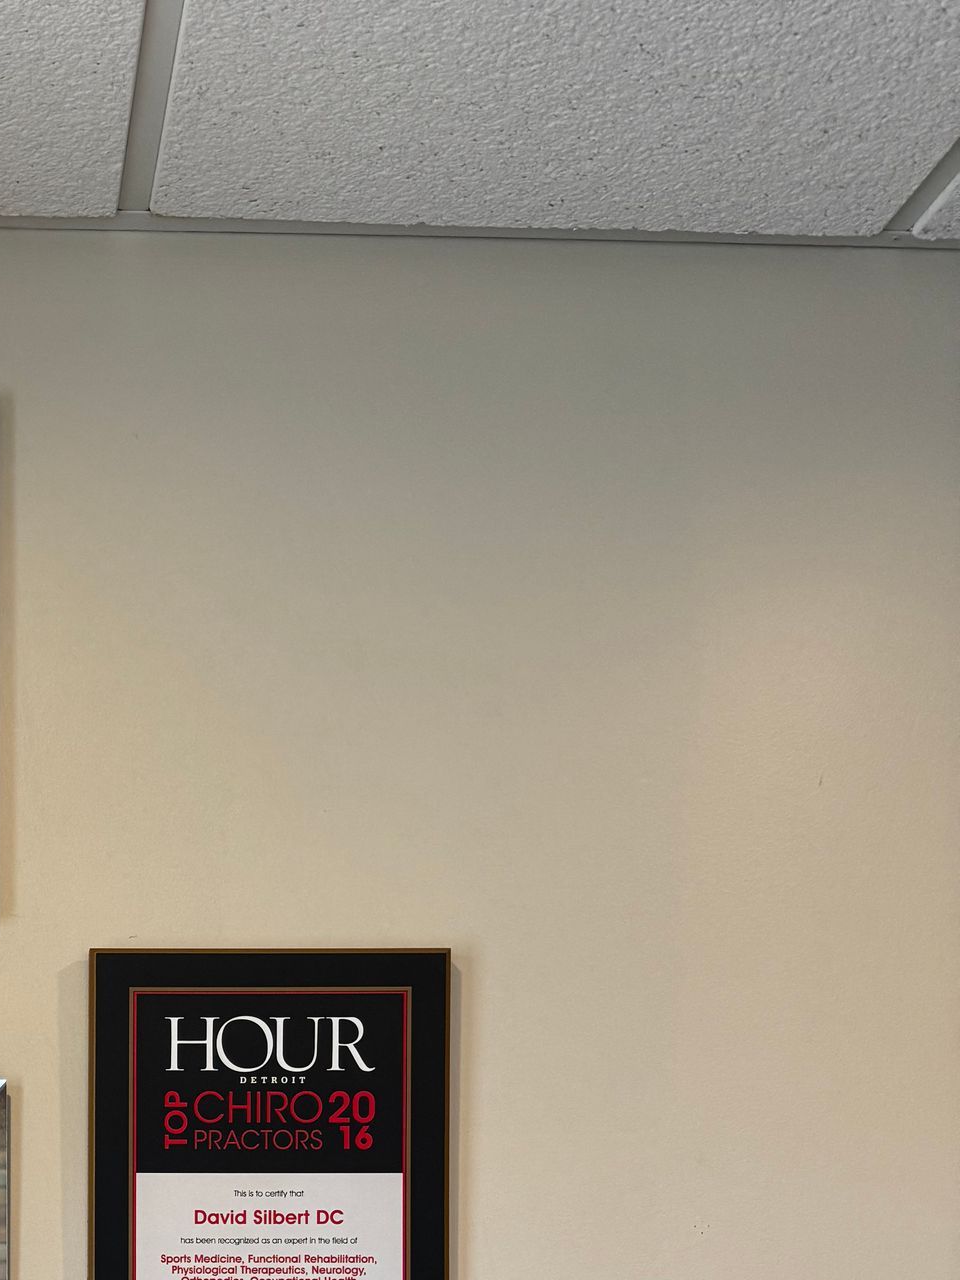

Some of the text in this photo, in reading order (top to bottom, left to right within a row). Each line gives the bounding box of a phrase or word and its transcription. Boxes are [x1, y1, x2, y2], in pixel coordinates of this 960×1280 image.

[164, 1015, 376, 1072] HOUR
[240, 1076, 307, 1084] DETROIT
[193, 1091, 323, 1124] CHIRO
[328, 1091, 376, 1124] 20
[164, 1091, 188, 1149] TOP
[194, 1130, 323, 1150] PRACTORS
[339, 1125, 373, 1150] 16
[194, 1210, 344, 1225] David Silbert DC
[161, 1254, 377, 1265] Sports Medicine, Functional Rehabilitation,
[171, 1265, 367, 1276] Physiological Therapeutics, Neurology,
